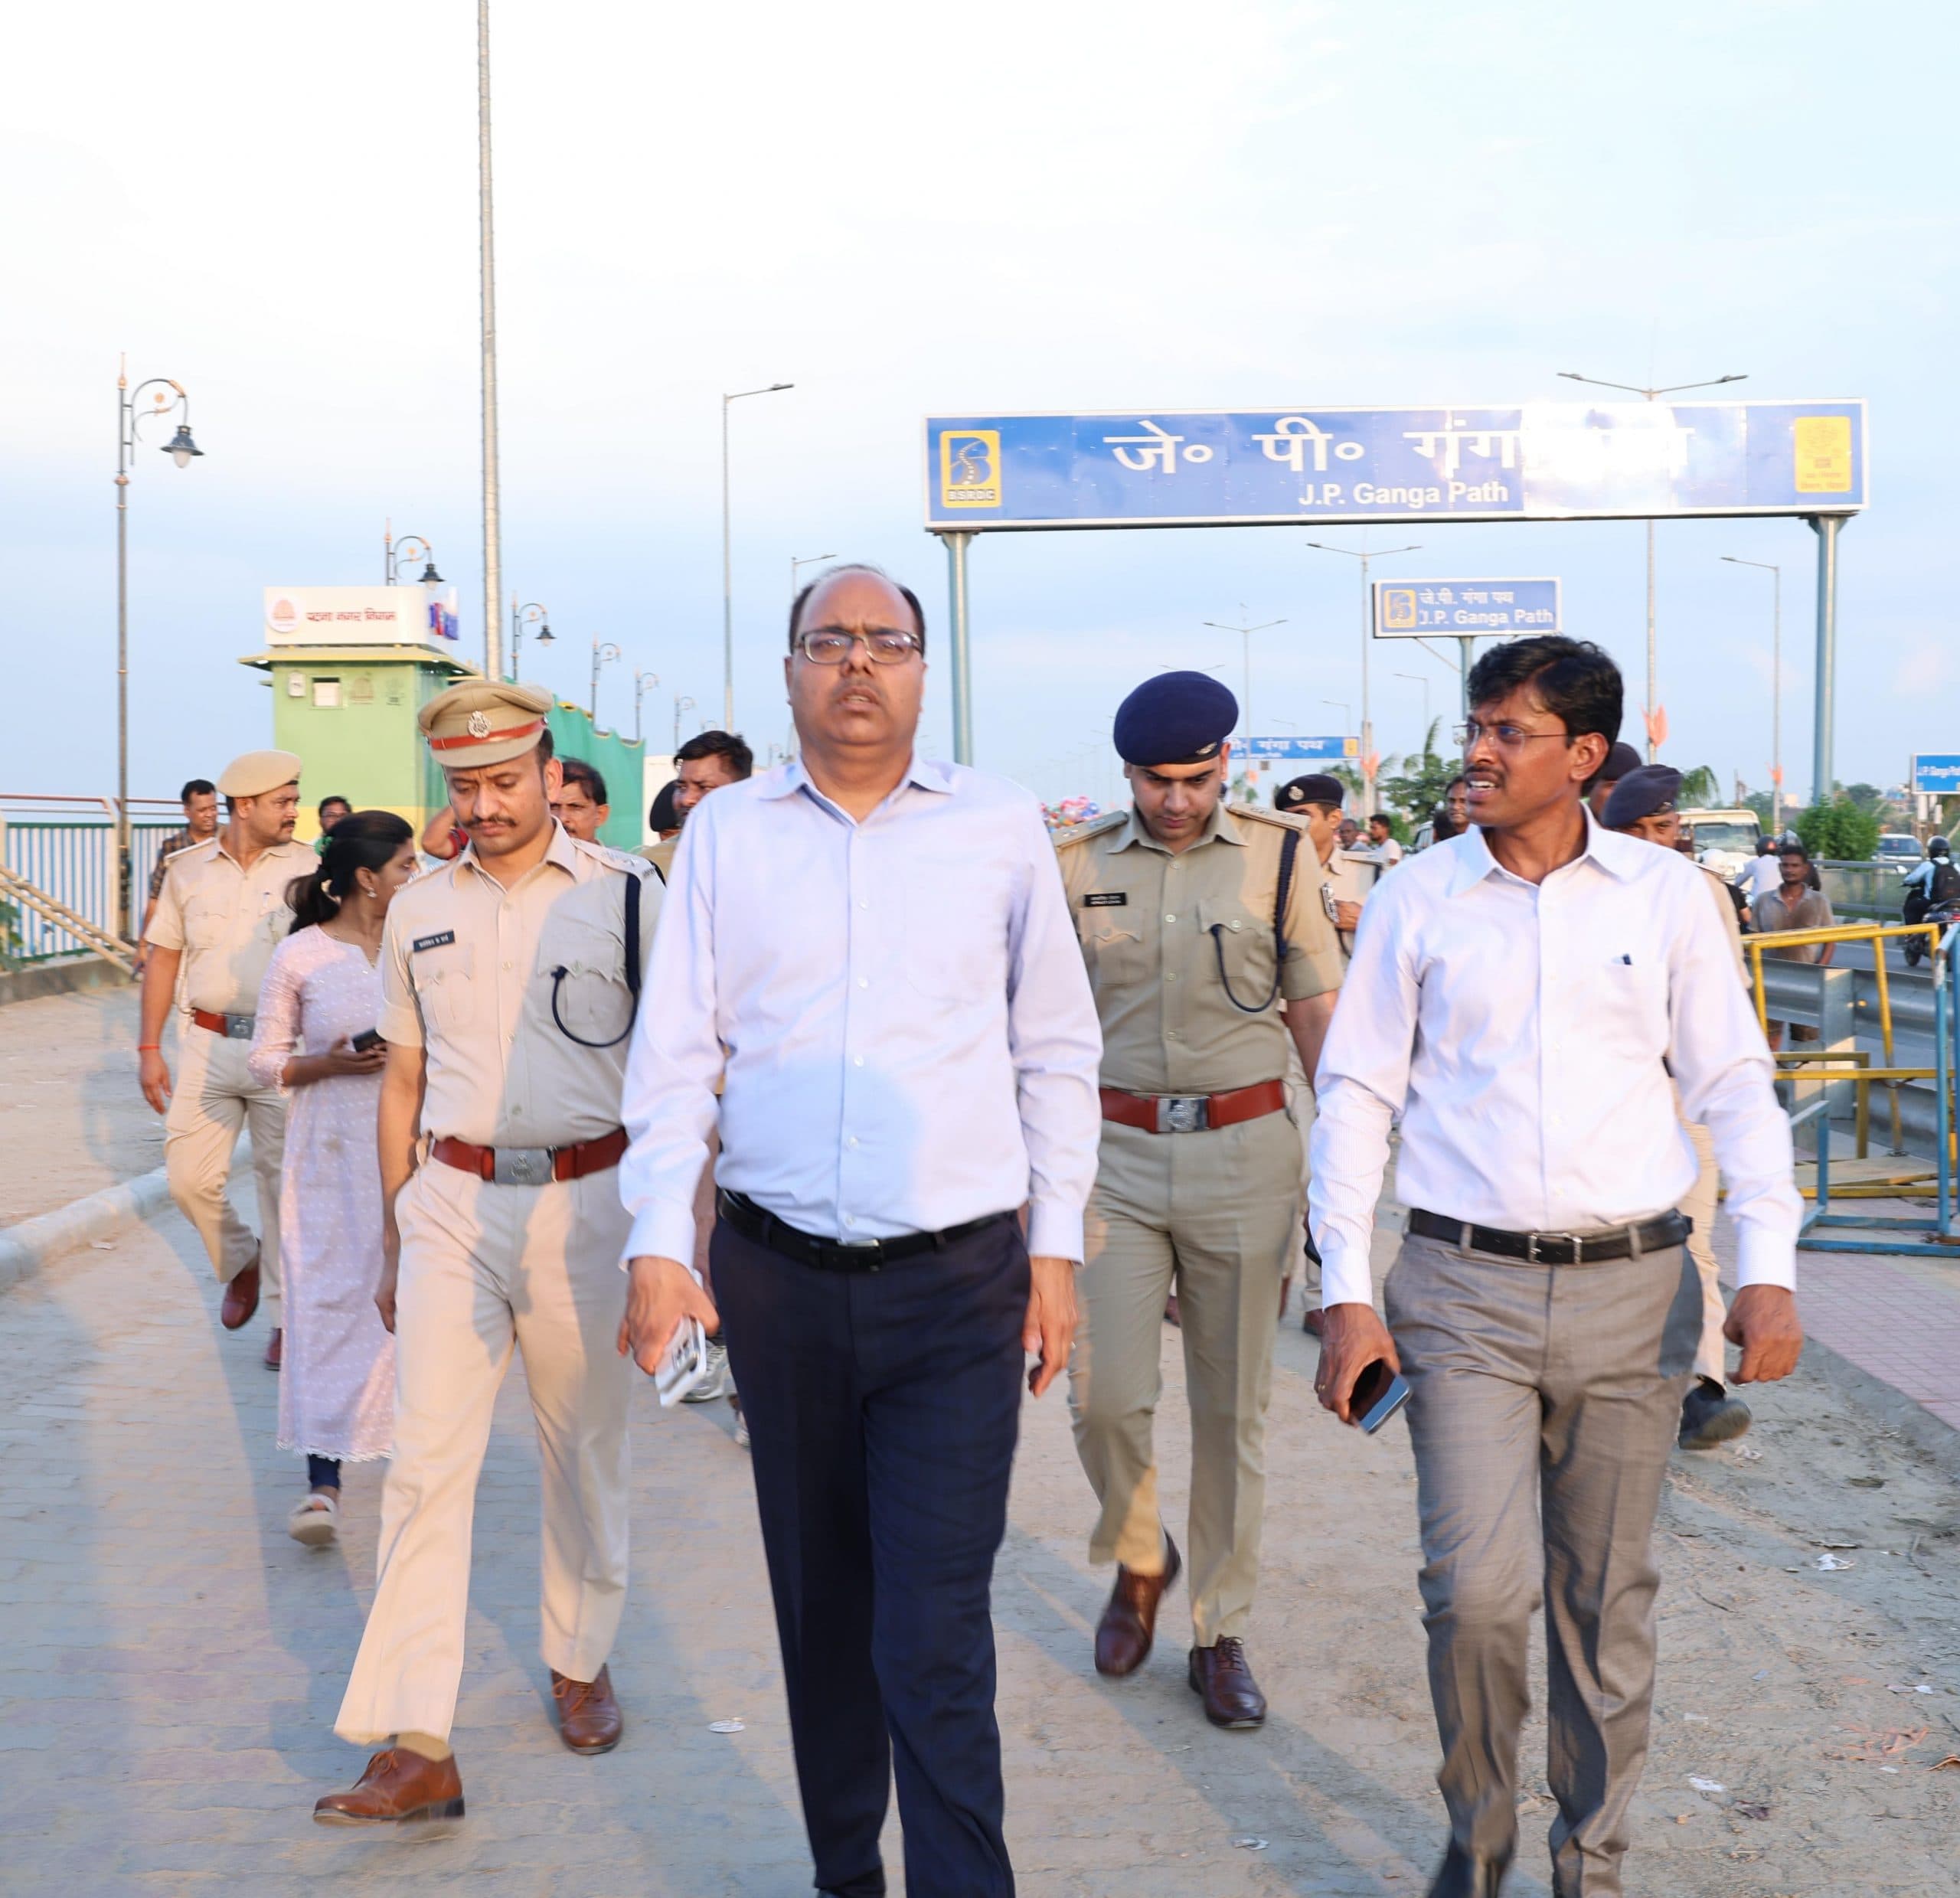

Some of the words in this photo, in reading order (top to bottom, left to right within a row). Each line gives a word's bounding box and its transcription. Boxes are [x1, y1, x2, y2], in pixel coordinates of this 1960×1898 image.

[1403, 418, 1522, 469] गंगा
[1298, 483, 1345, 506] J.P.
[1353, 482, 1441, 508] Ganga
[1448, 480, 1509, 503] Path
[1419, 609, 1449, 626] J.P.
[1455, 609, 1509, 626] Ganga
[1514, 608, 1553, 624] Path
